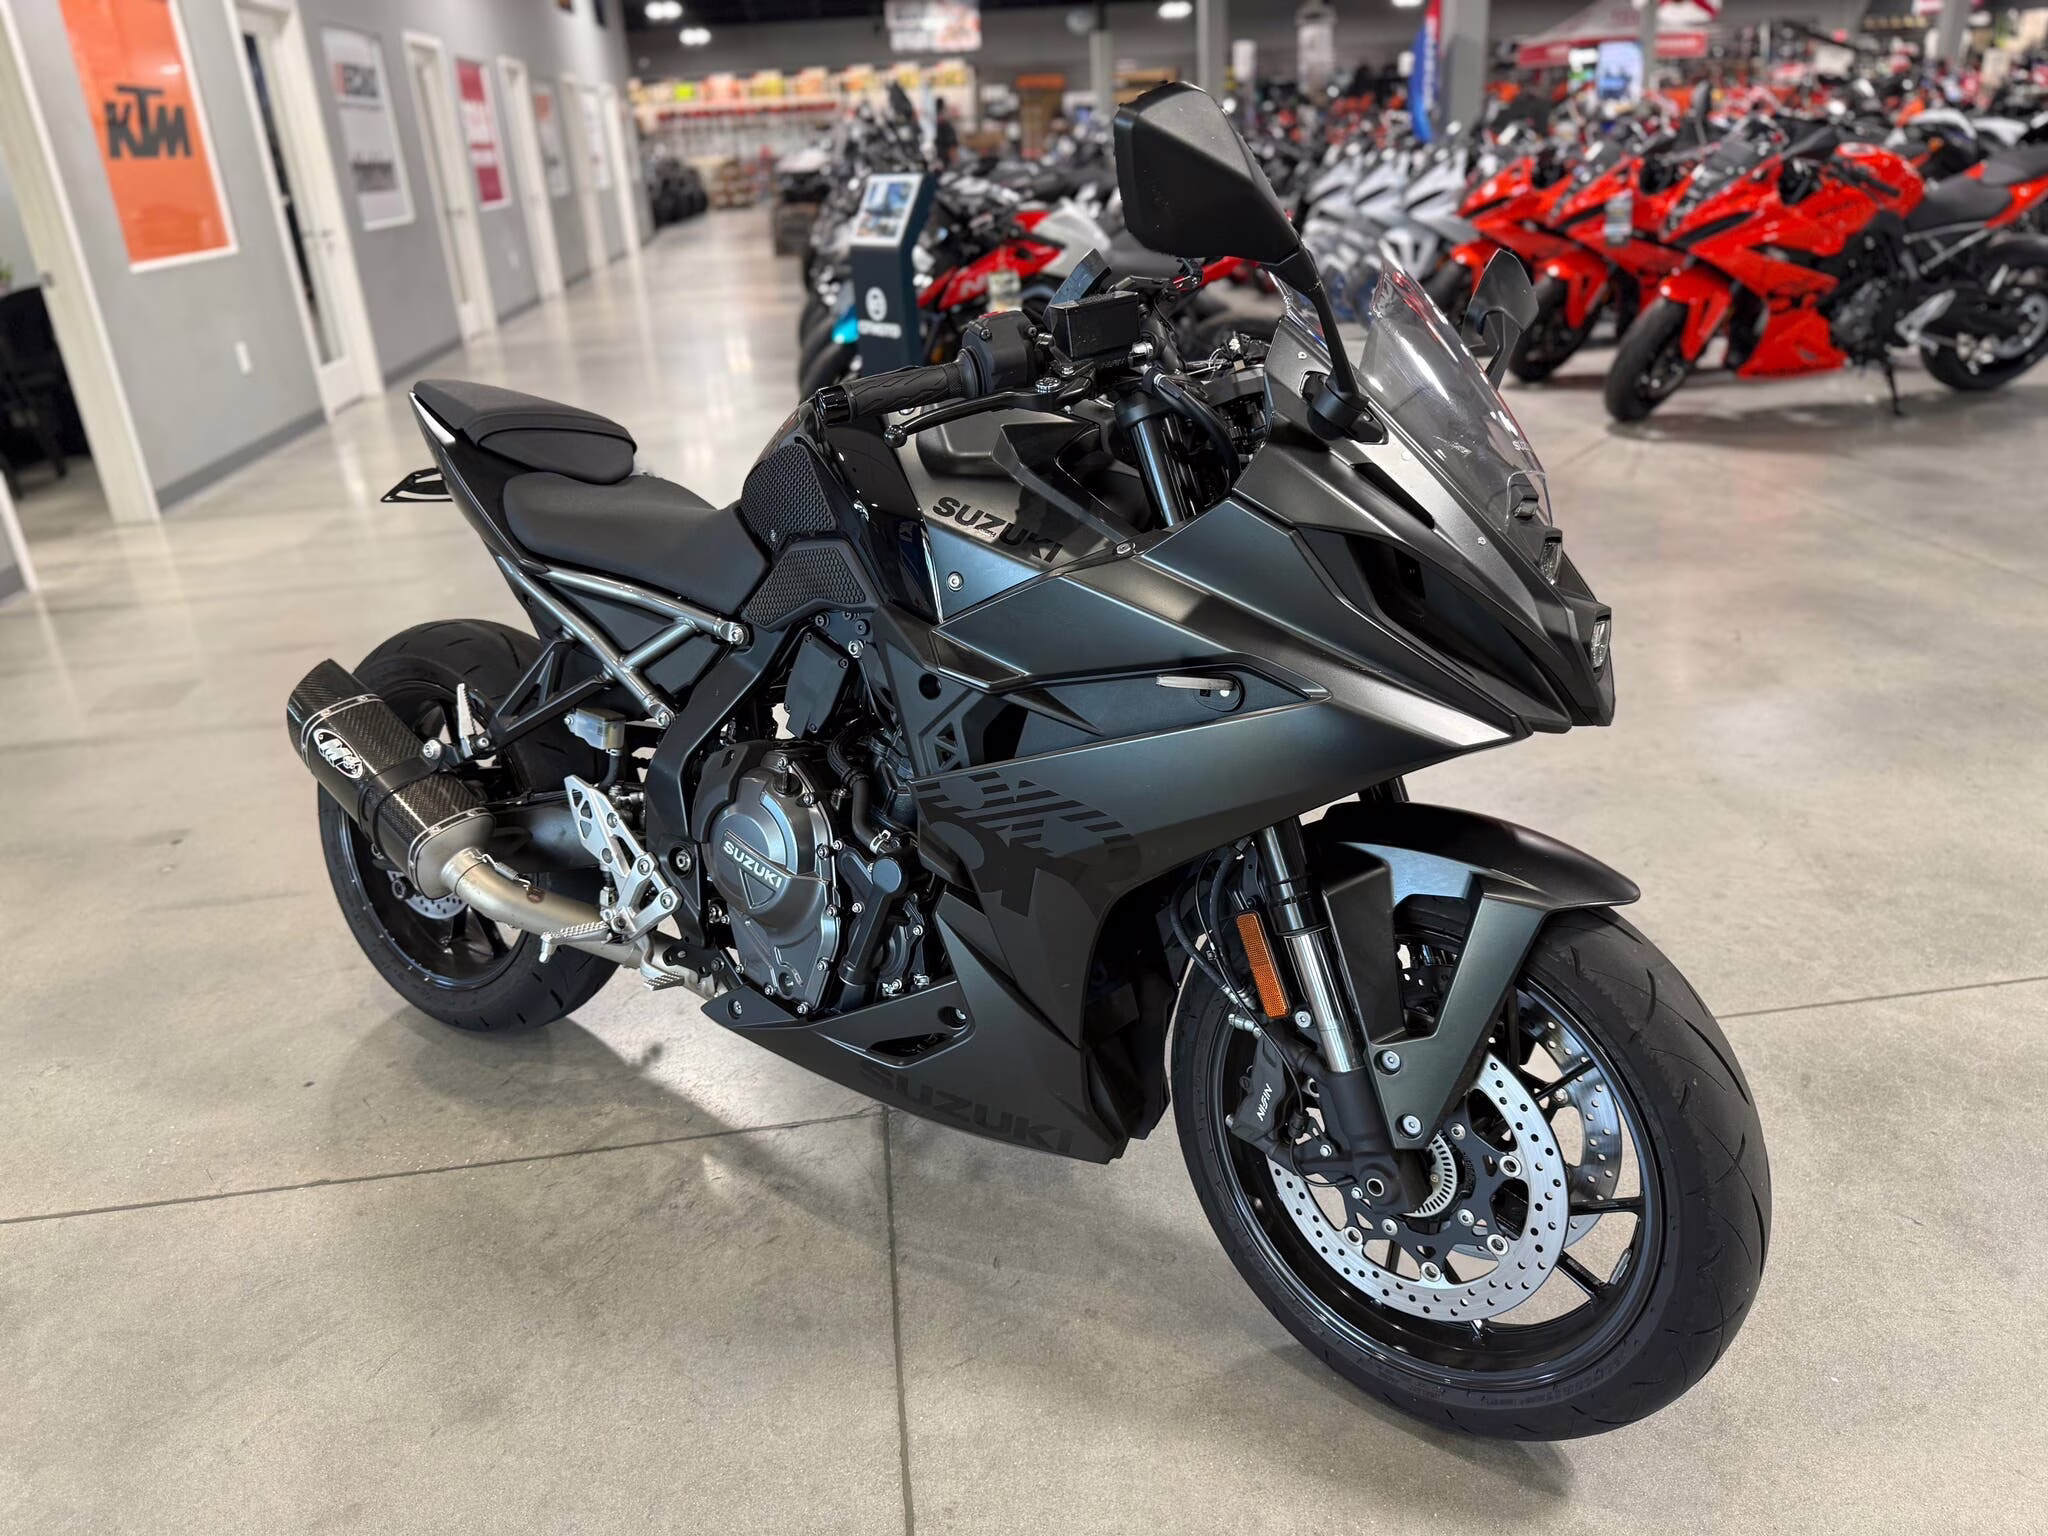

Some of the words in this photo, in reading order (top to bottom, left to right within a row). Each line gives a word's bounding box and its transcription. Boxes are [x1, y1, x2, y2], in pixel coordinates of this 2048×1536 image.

[104, 84, 193, 158] KTM
[933, 496, 1063, 563] SUZUKI
[723, 840, 782, 889] SUZUKI
[860, 1060, 1074, 1153] SUZUKI
